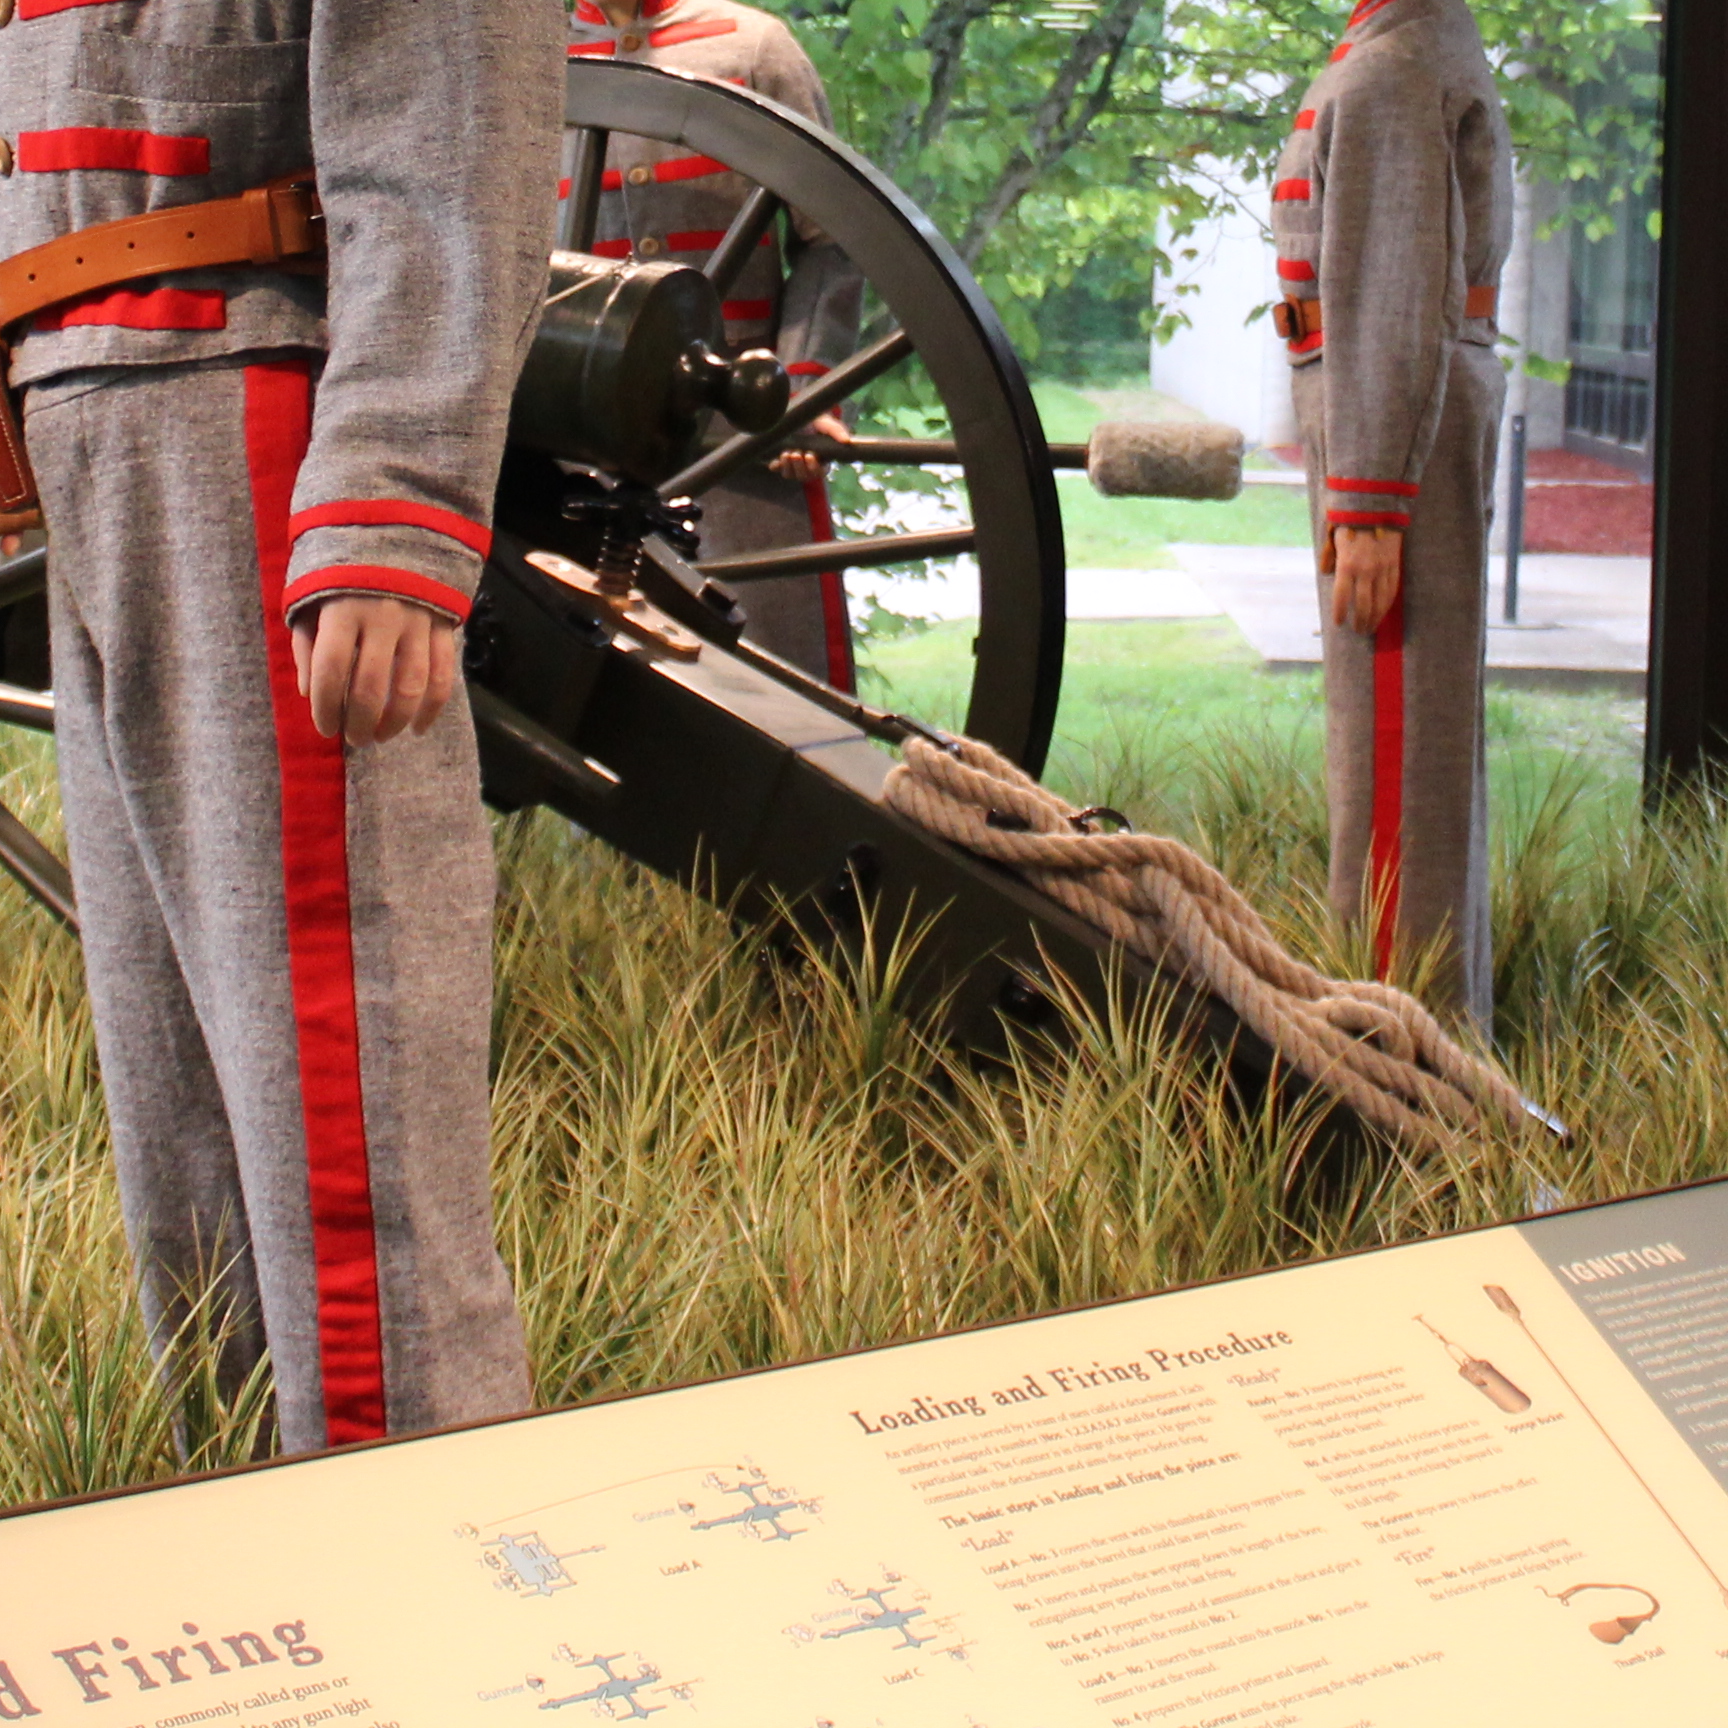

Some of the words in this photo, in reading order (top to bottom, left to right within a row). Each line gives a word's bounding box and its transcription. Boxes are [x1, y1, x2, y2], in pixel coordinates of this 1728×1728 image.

[1560, 1243, 1685, 1283] IGNITION
[850, 1396, 986, 1434] Loading
[991, 1374, 1048, 1406] and
[1047, 1361, 1150, 1392] Firing
[1146, 1331, 1292, 1371] Procedure
[938, 1514, 969, 1529] The
[967, 1506, 1005, 1523] basic
[1005, 1499, 1039, 1514] steps
[1036, 1494, 1055, 1506] in
[1052, 1484, 1104, 1502] loading
[1103, 1474, 1128, 1491] and
[1125, 1470, 1165, 1485] firing
[1162, 1463, 1184, 1476] the
[1185, 1457, 1217, 1473] piece
[1218, 1452, 1241, 1464] are:
[960, 1529, 1014, 1552] “Load”
[659, 1562, 691, 1577] Load
[691, 1560, 703, 1571] A
[52, 1621, 324, 1703] Firing
[883, 1669, 913, 1685] Load
[913, 1666, 925, 1678] C
[154, 1701, 241, 1728] commonly
[243, 1687, 290, 1710] called
[292, 1679, 332, 1702] guns
[332, 1675, 351, 1689] or
[302, 1707, 335, 1725] gun
[335, 1697, 373, 1717] light
